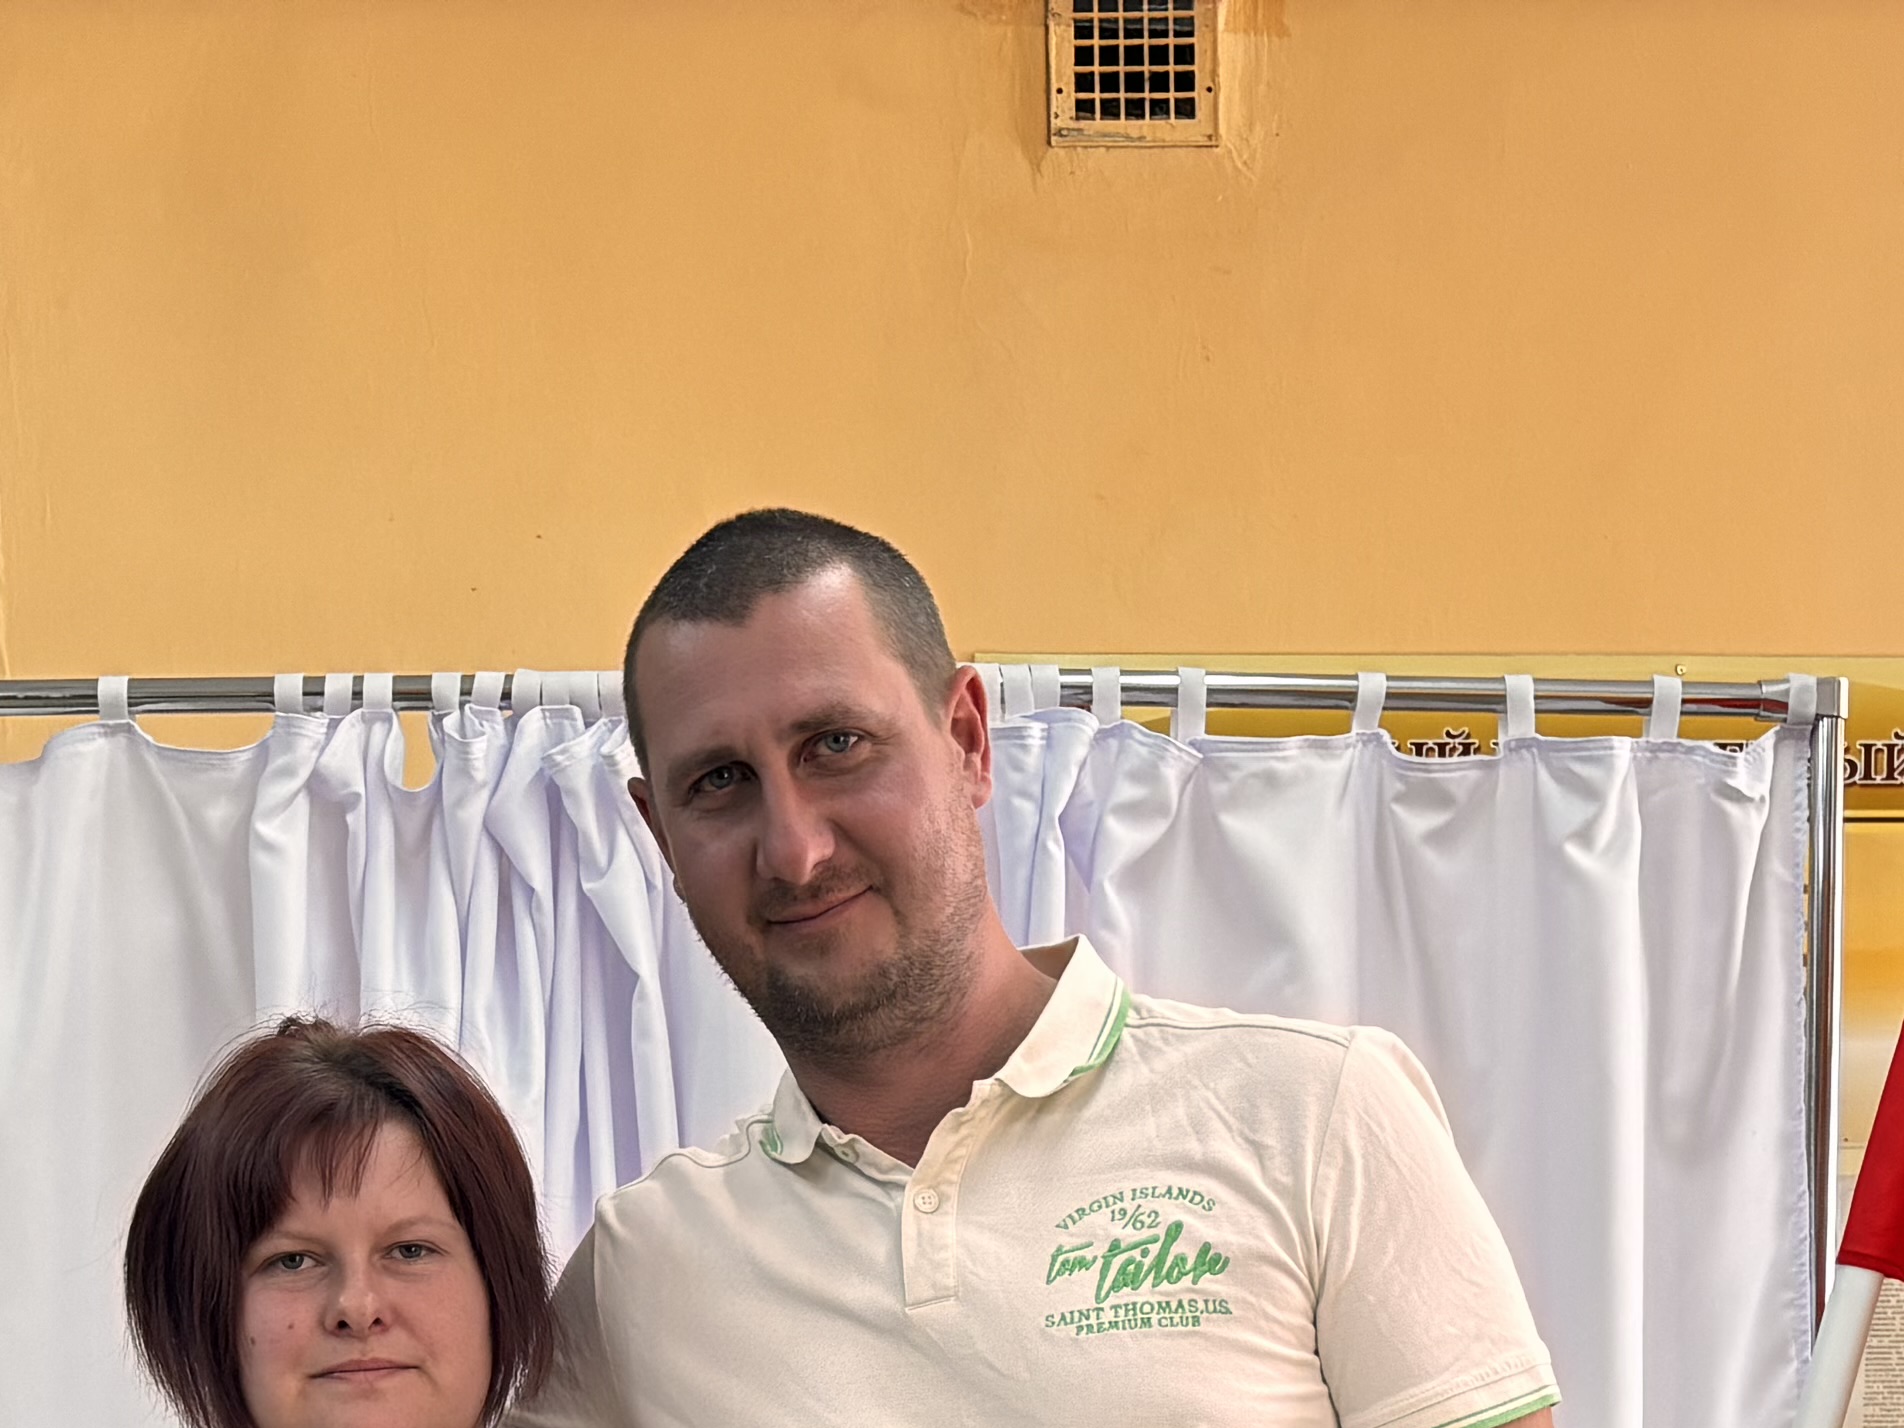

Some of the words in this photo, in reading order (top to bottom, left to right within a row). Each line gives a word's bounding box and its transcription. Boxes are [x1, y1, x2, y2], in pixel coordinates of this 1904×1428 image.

[1055, 1190, 1125, 1232] VIRGIN
[1130, 1185, 1217, 1213] ISLANDS
[1109, 1203, 1162, 1232] 19/62
[1045, 1307, 1105, 1328] SAINT
[1075, 1317, 1153, 1336] PREMIUM
[1157, 1315, 1201, 1328] CLUB
